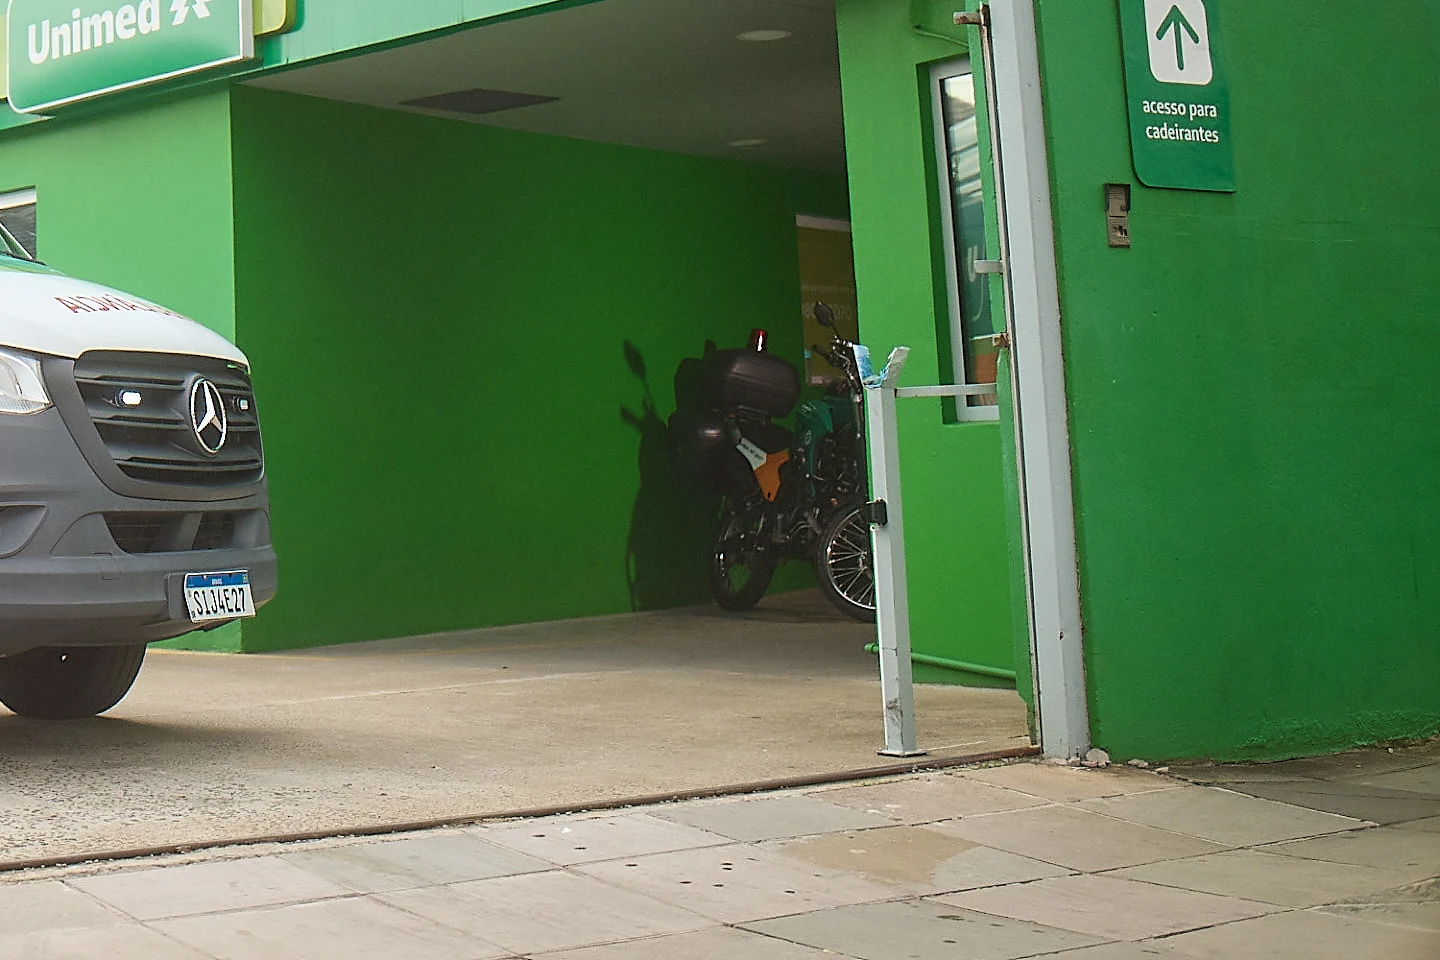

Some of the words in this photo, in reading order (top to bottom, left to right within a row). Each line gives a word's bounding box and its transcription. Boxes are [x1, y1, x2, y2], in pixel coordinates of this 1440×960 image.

[1142, 100, 1186, 116] acesso
[1189, 103, 1217, 121] para
[1145, 122, 1220, 143] cadeirantes
